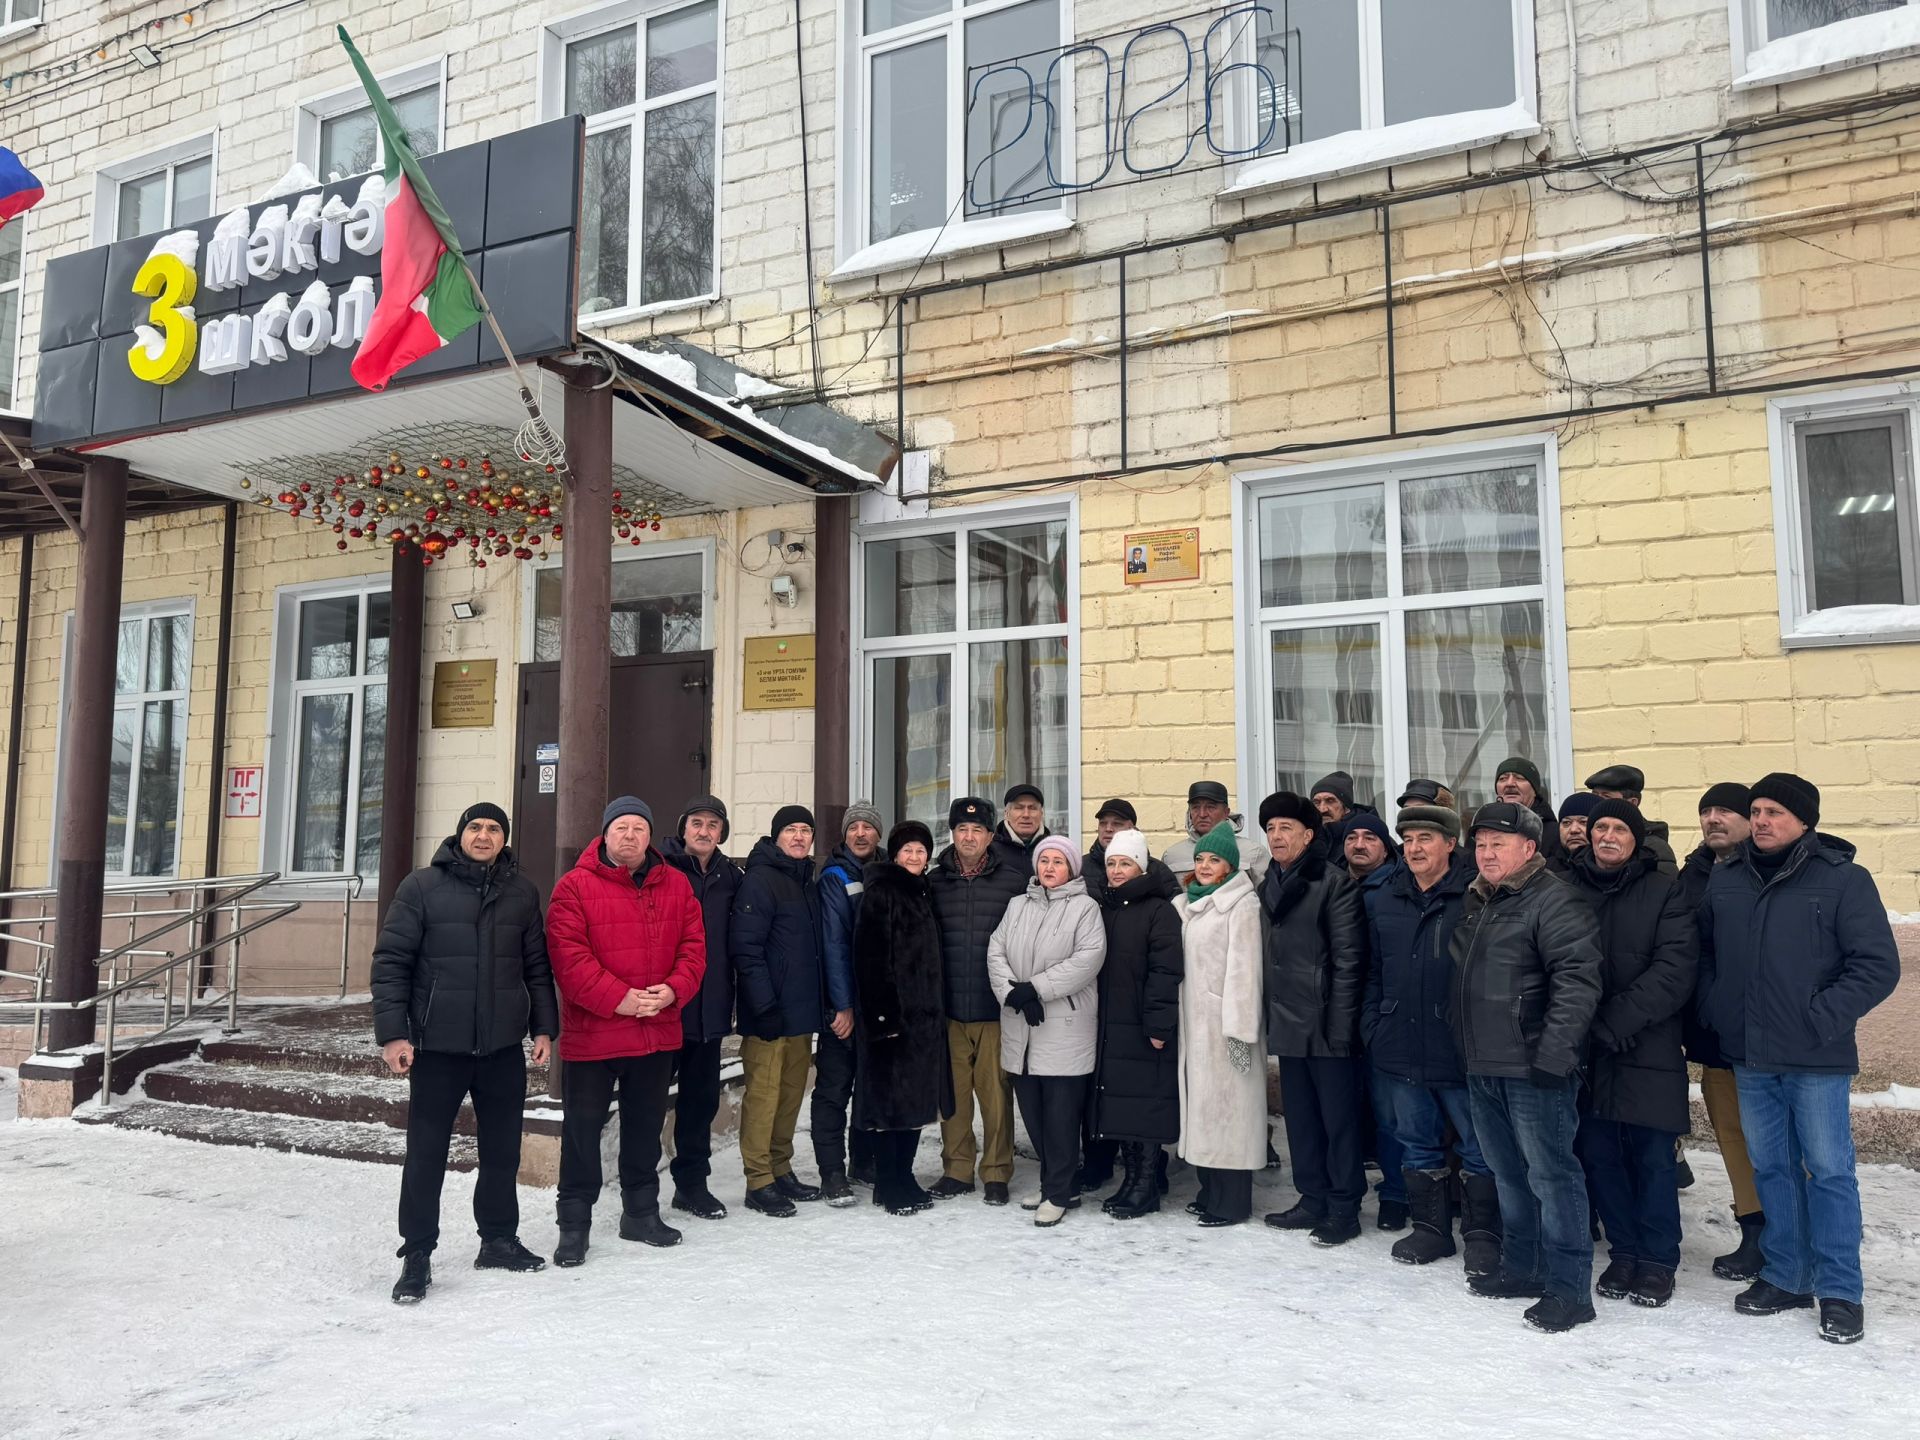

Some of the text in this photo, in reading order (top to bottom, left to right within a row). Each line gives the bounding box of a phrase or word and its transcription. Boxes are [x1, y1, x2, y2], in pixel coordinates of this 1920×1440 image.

[967, 7, 1277, 207] 2026
[205, 199, 385, 291] МӘКТӘ
[127, 251, 198, 385] 3
[199, 289, 376, 375] ШКОЛ
[233, 770, 256, 788] ПГ
